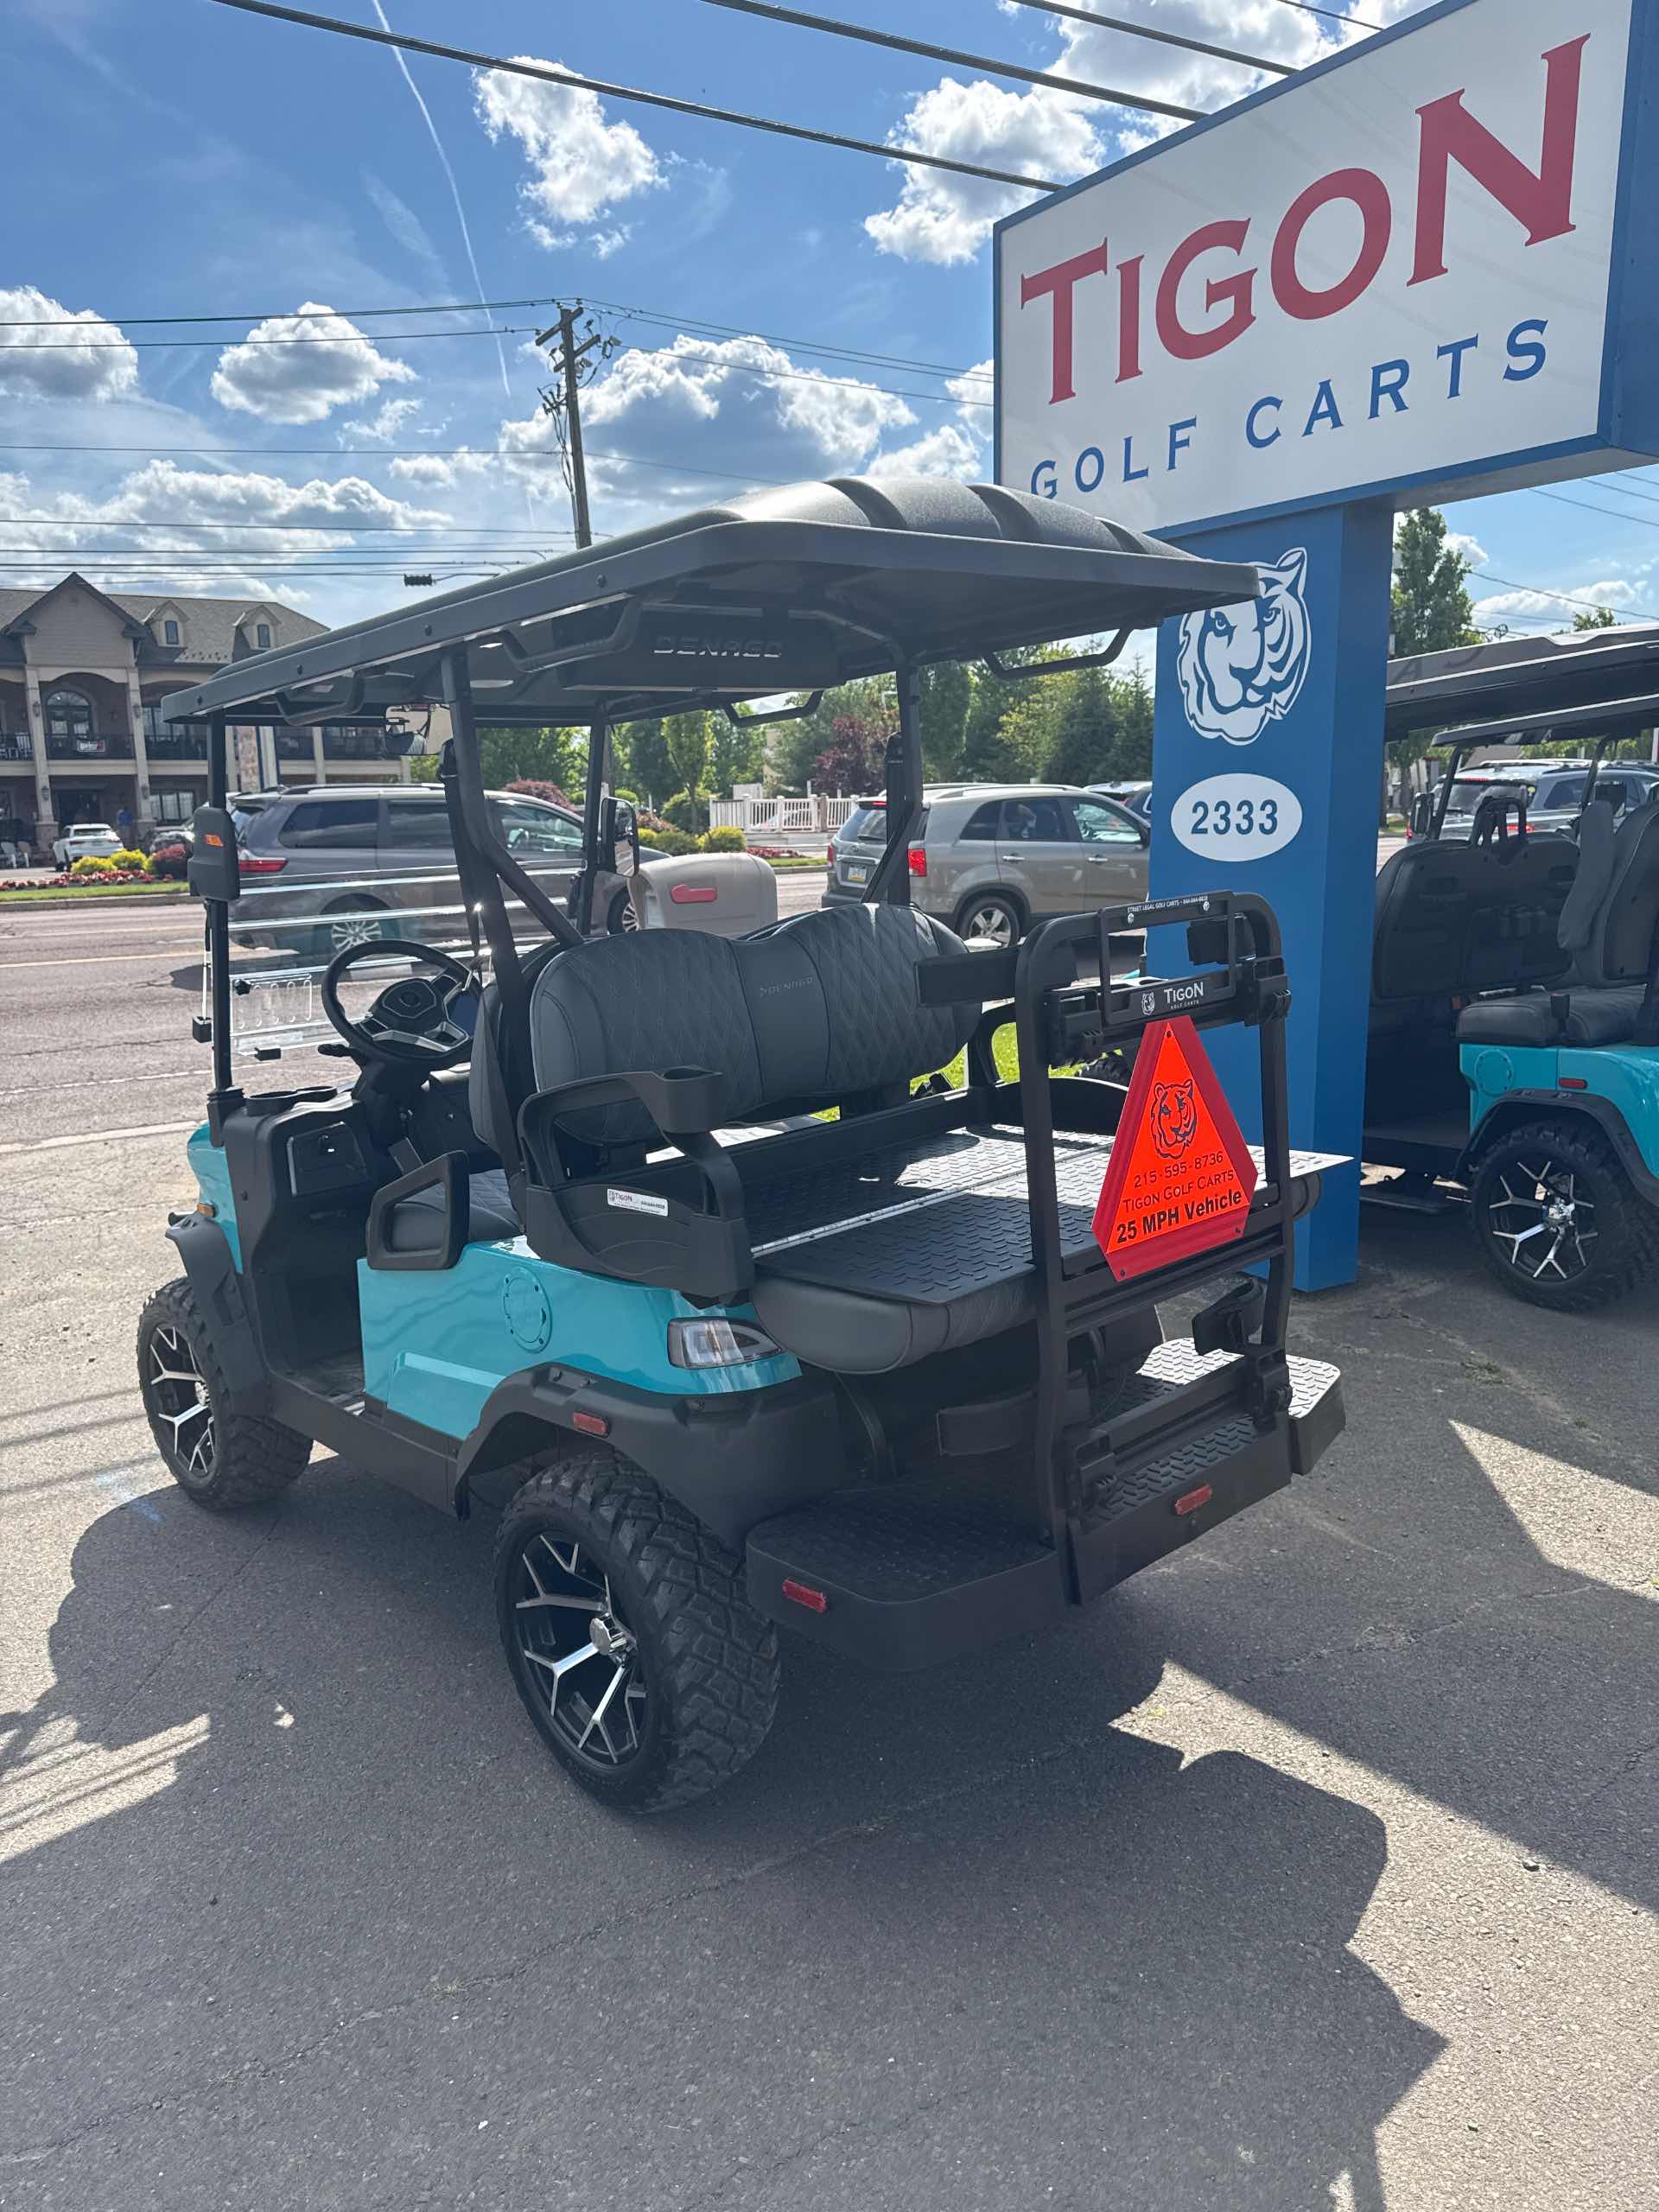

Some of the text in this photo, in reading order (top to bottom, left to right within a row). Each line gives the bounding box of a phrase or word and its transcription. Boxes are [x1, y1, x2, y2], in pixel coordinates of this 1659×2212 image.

[1020, 33, 1592, 404] TIGON
[1031, 319, 1549, 500] GOLF CARTS
[1191, 799, 1279, 836] 2333
[1127, 905, 1142, 913] STREET
[1142, 902, 1155, 911] LEGAL
[1163, 982, 1204, 1004] TIGON
[1134, 1151, 1224, 1188] 215-595-8736
[1122, 1169, 1234, 1213] TIGON GOLF CARTS
[1116, 1188, 1242, 1244] 25 MPH Vehicle
